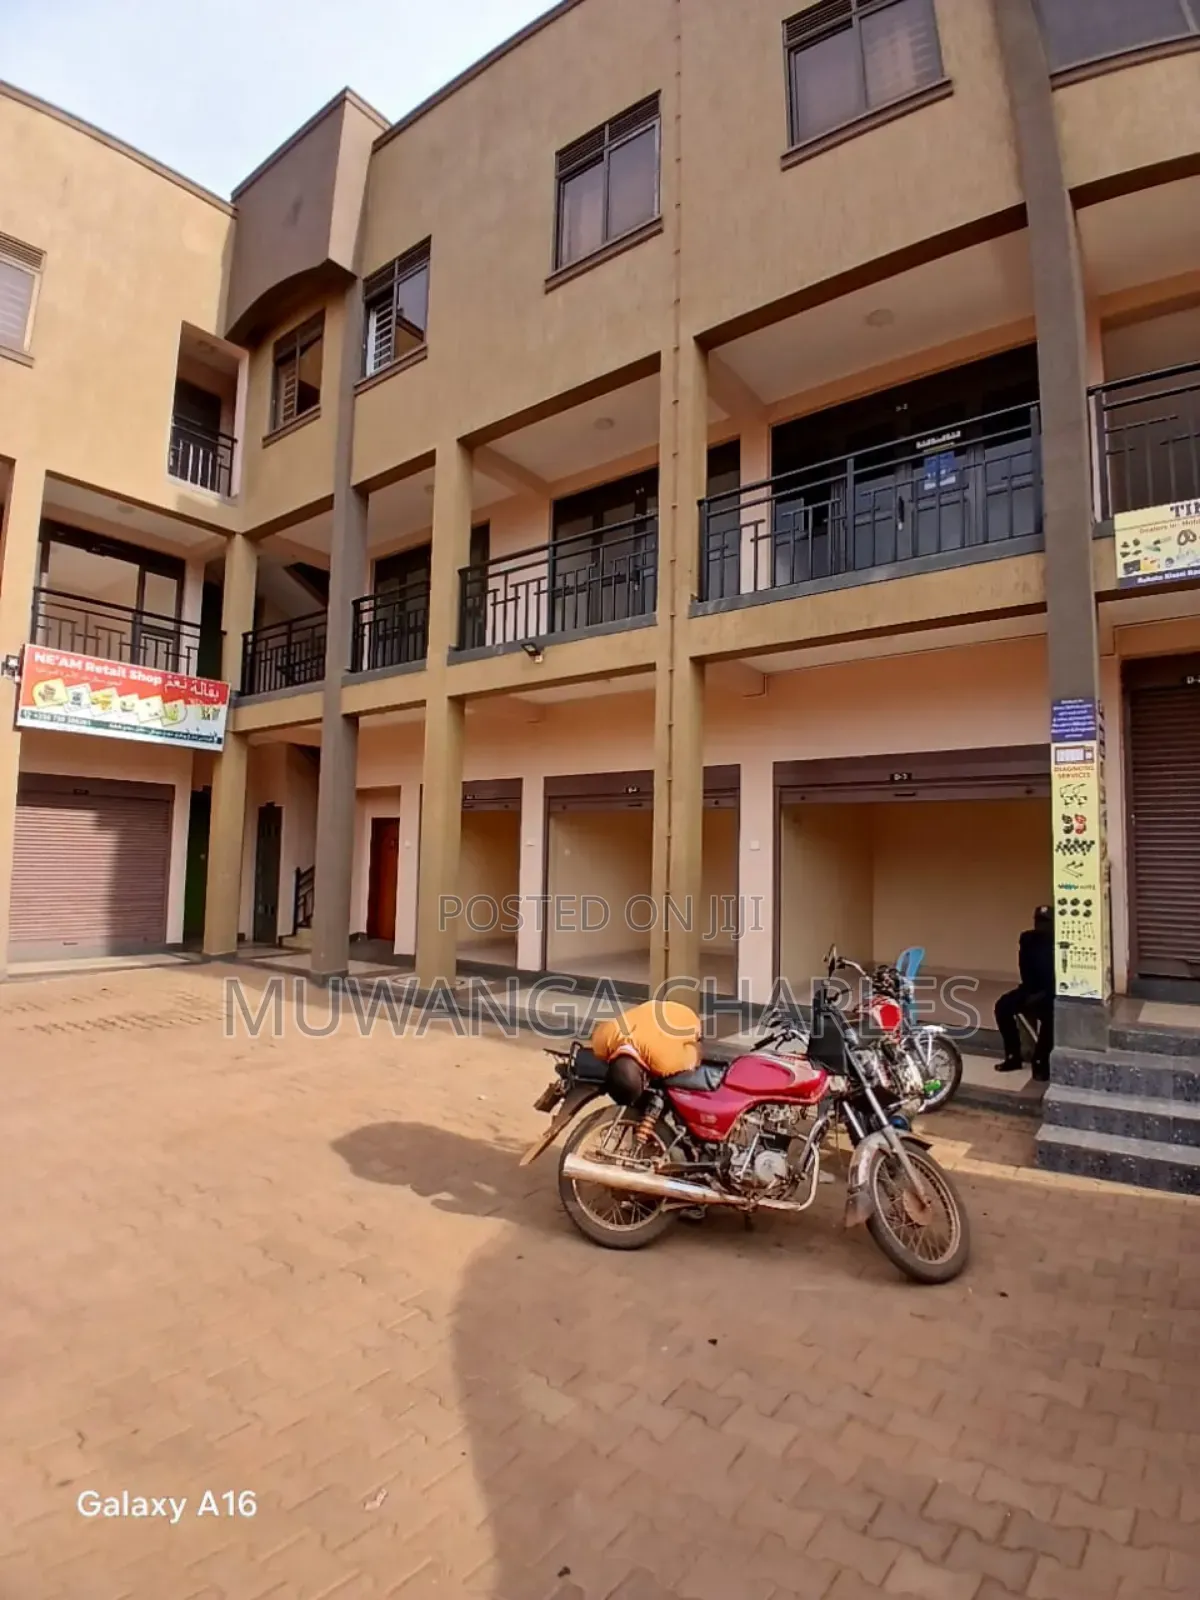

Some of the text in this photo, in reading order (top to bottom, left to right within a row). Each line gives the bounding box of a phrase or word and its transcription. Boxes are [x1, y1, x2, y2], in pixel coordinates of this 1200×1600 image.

[34, 652, 83, 671] NE'AM
[86, 661, 127, 678] Retail
[130, 669, 163, 687] Shop
